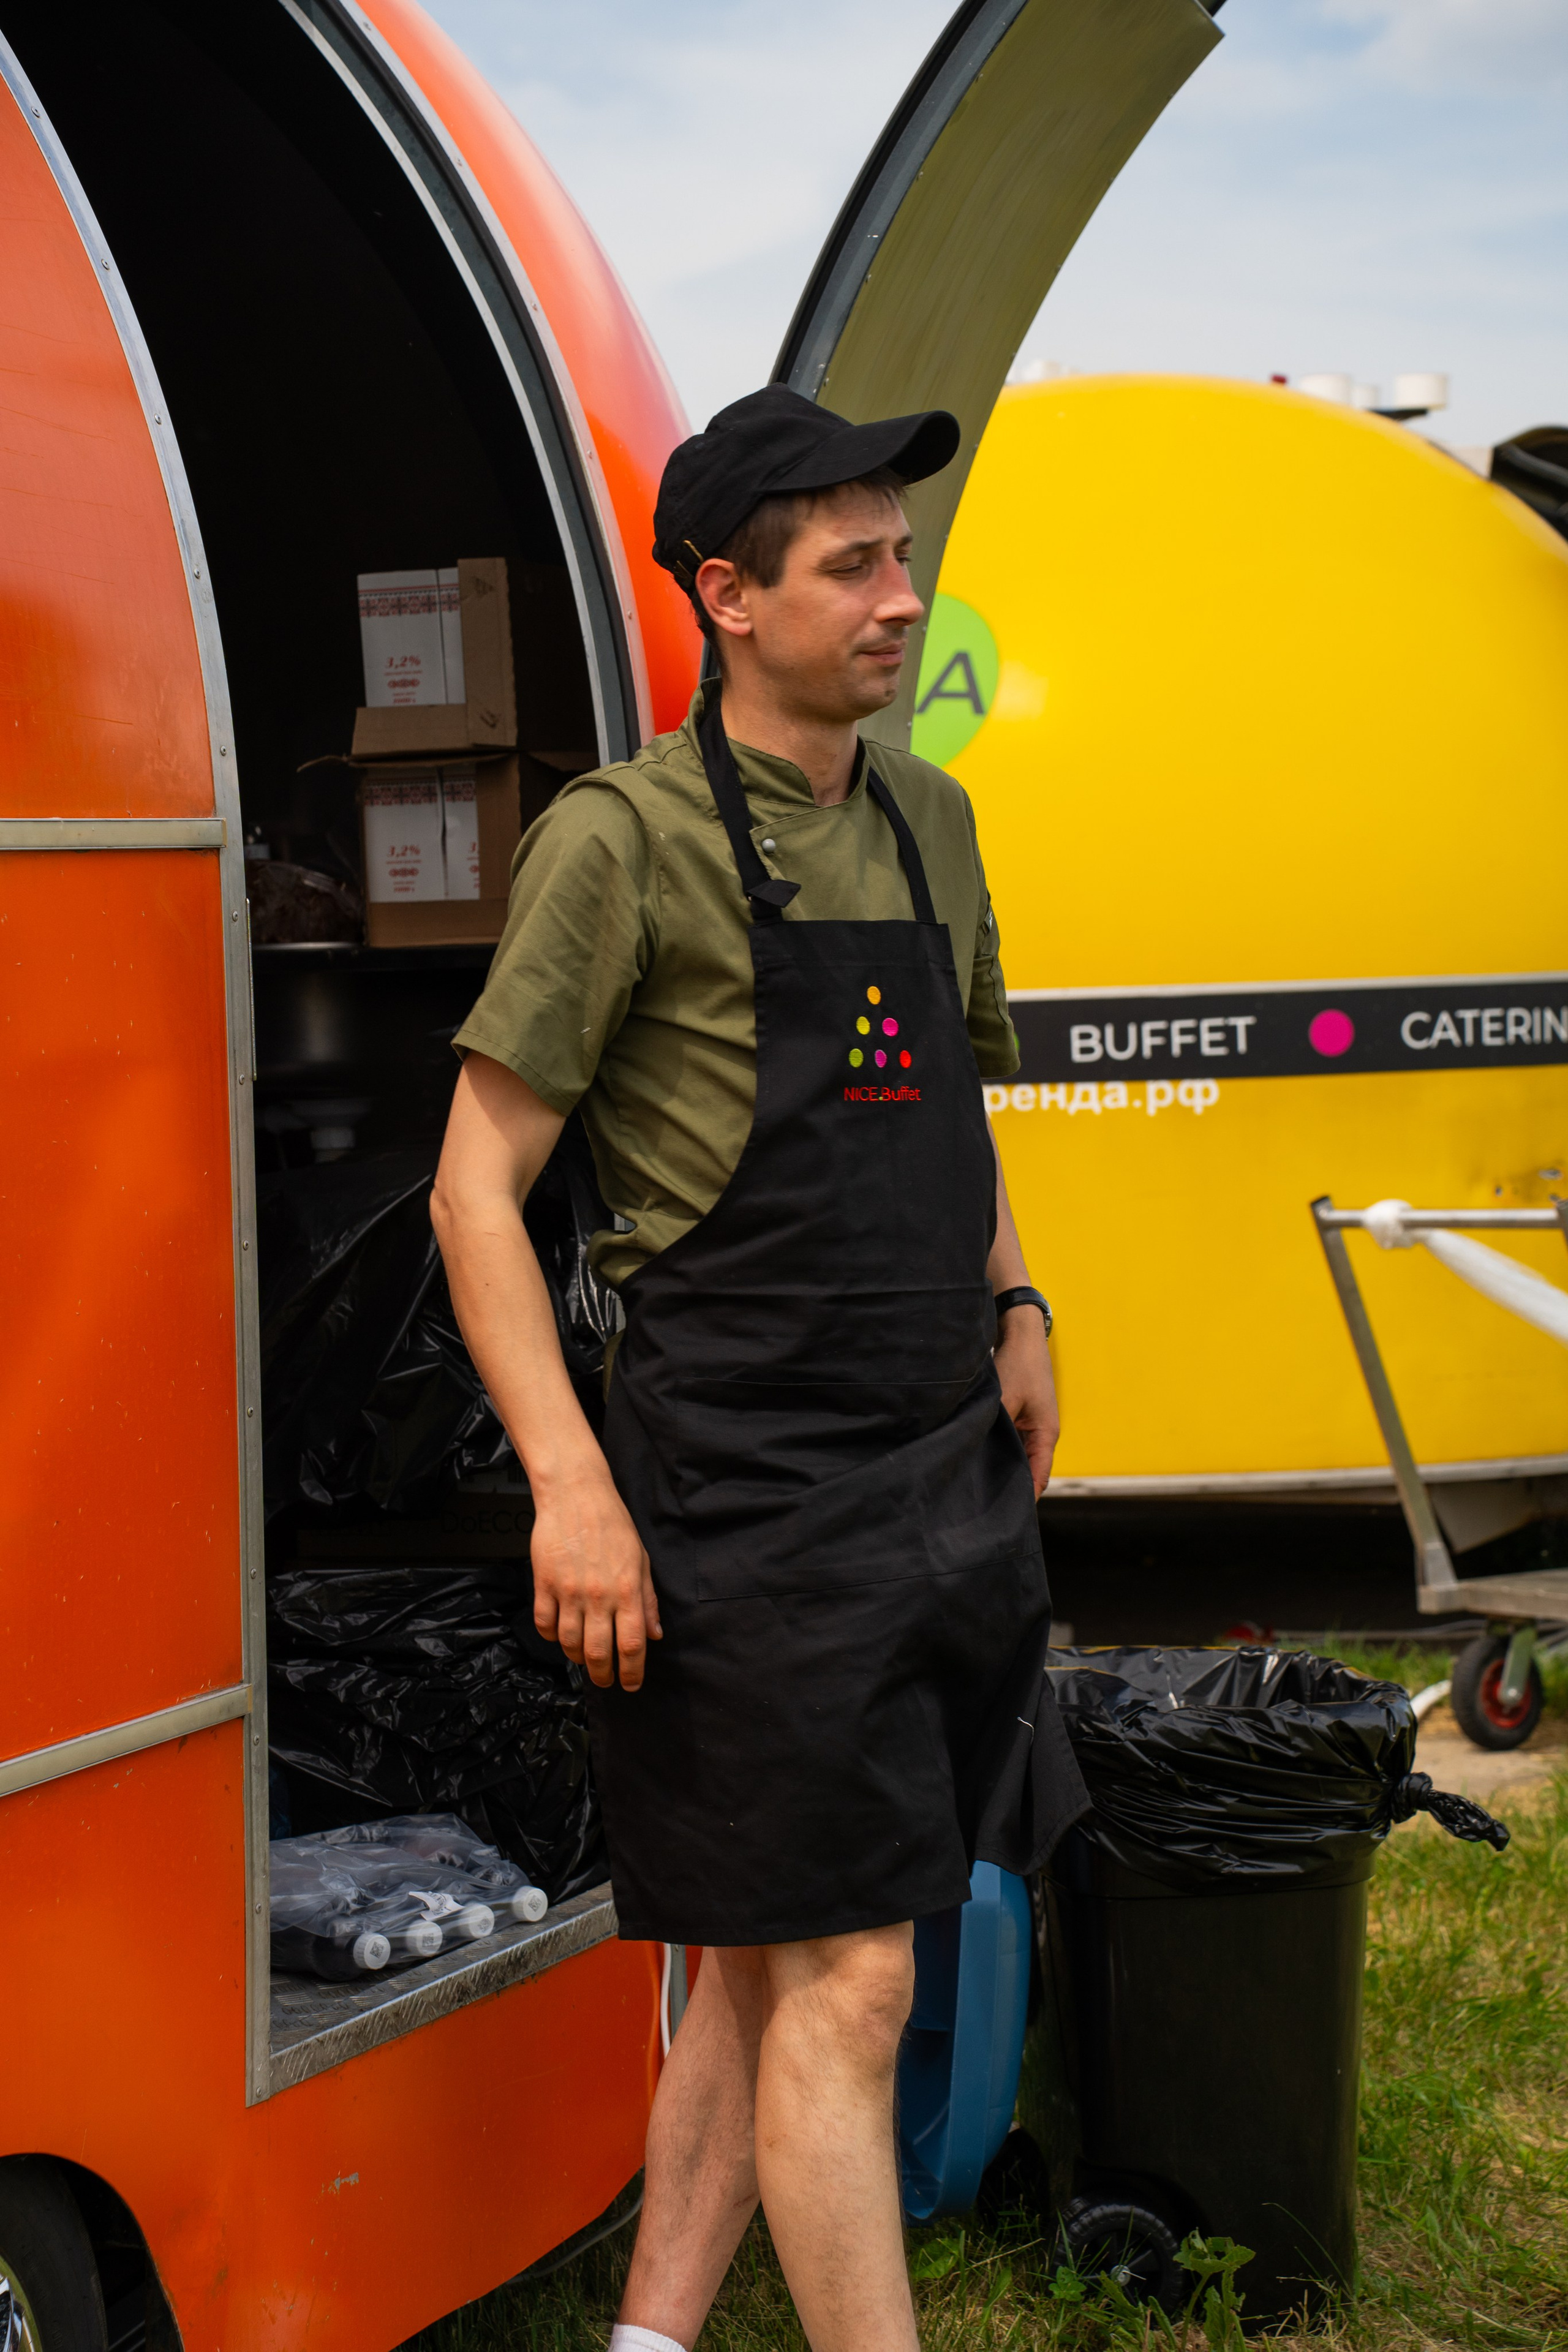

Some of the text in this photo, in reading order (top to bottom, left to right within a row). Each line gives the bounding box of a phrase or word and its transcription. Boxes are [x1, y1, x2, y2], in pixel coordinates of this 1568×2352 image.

[385, 655, 421, 669] 3,2%
[387, 845, 420, 858] 3,2%
[1069, 1005, 1568, 1063] BUFFET CATERIN
